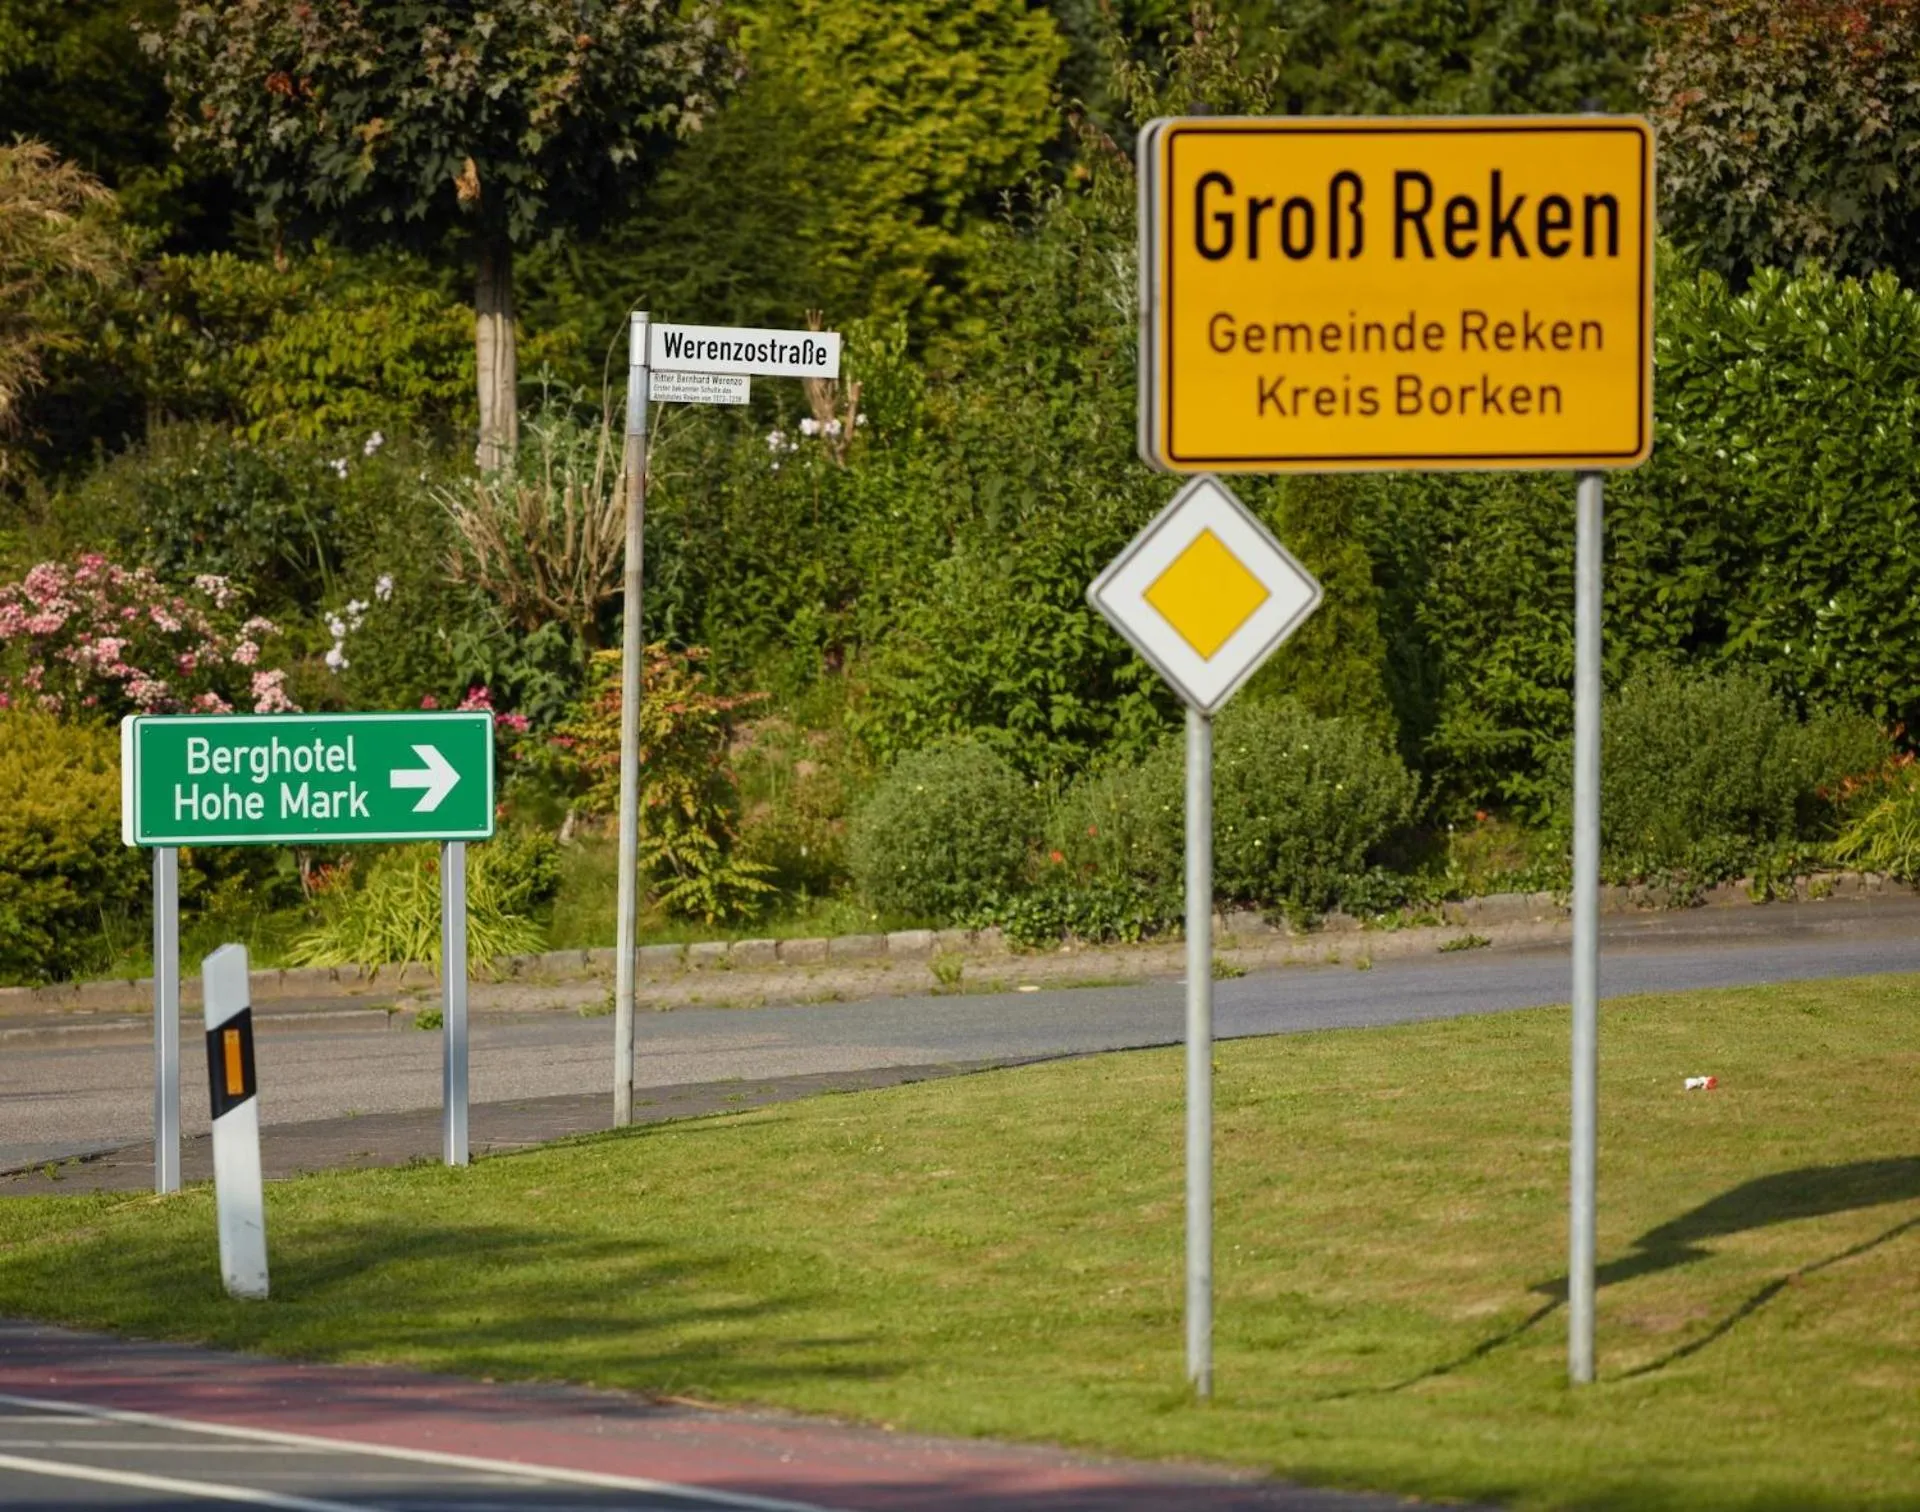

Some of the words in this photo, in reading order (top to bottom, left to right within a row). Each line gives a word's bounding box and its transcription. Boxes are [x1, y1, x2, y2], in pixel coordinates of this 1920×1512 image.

[1195, 170, 1363, 261] Groß
[1394, 170, 1618, 259] Reken
[664, 331, 828, 366] Werenzostraße
[1209, 311, 1445, 353] Gemeinde
[1461, 310, 1603, 352] Reken
[676, 374, 710, 384] Bernhard
[712, 376, 743, 386] Werenzo
[1258, 375, 1380, 416] Kreis
[1396, 374, 1562, 416] Borken
[187, 735, 356, 784] Berghotel
[174, 783, 265, 821] Hohe
[280, 782, 370, 819] Mark
